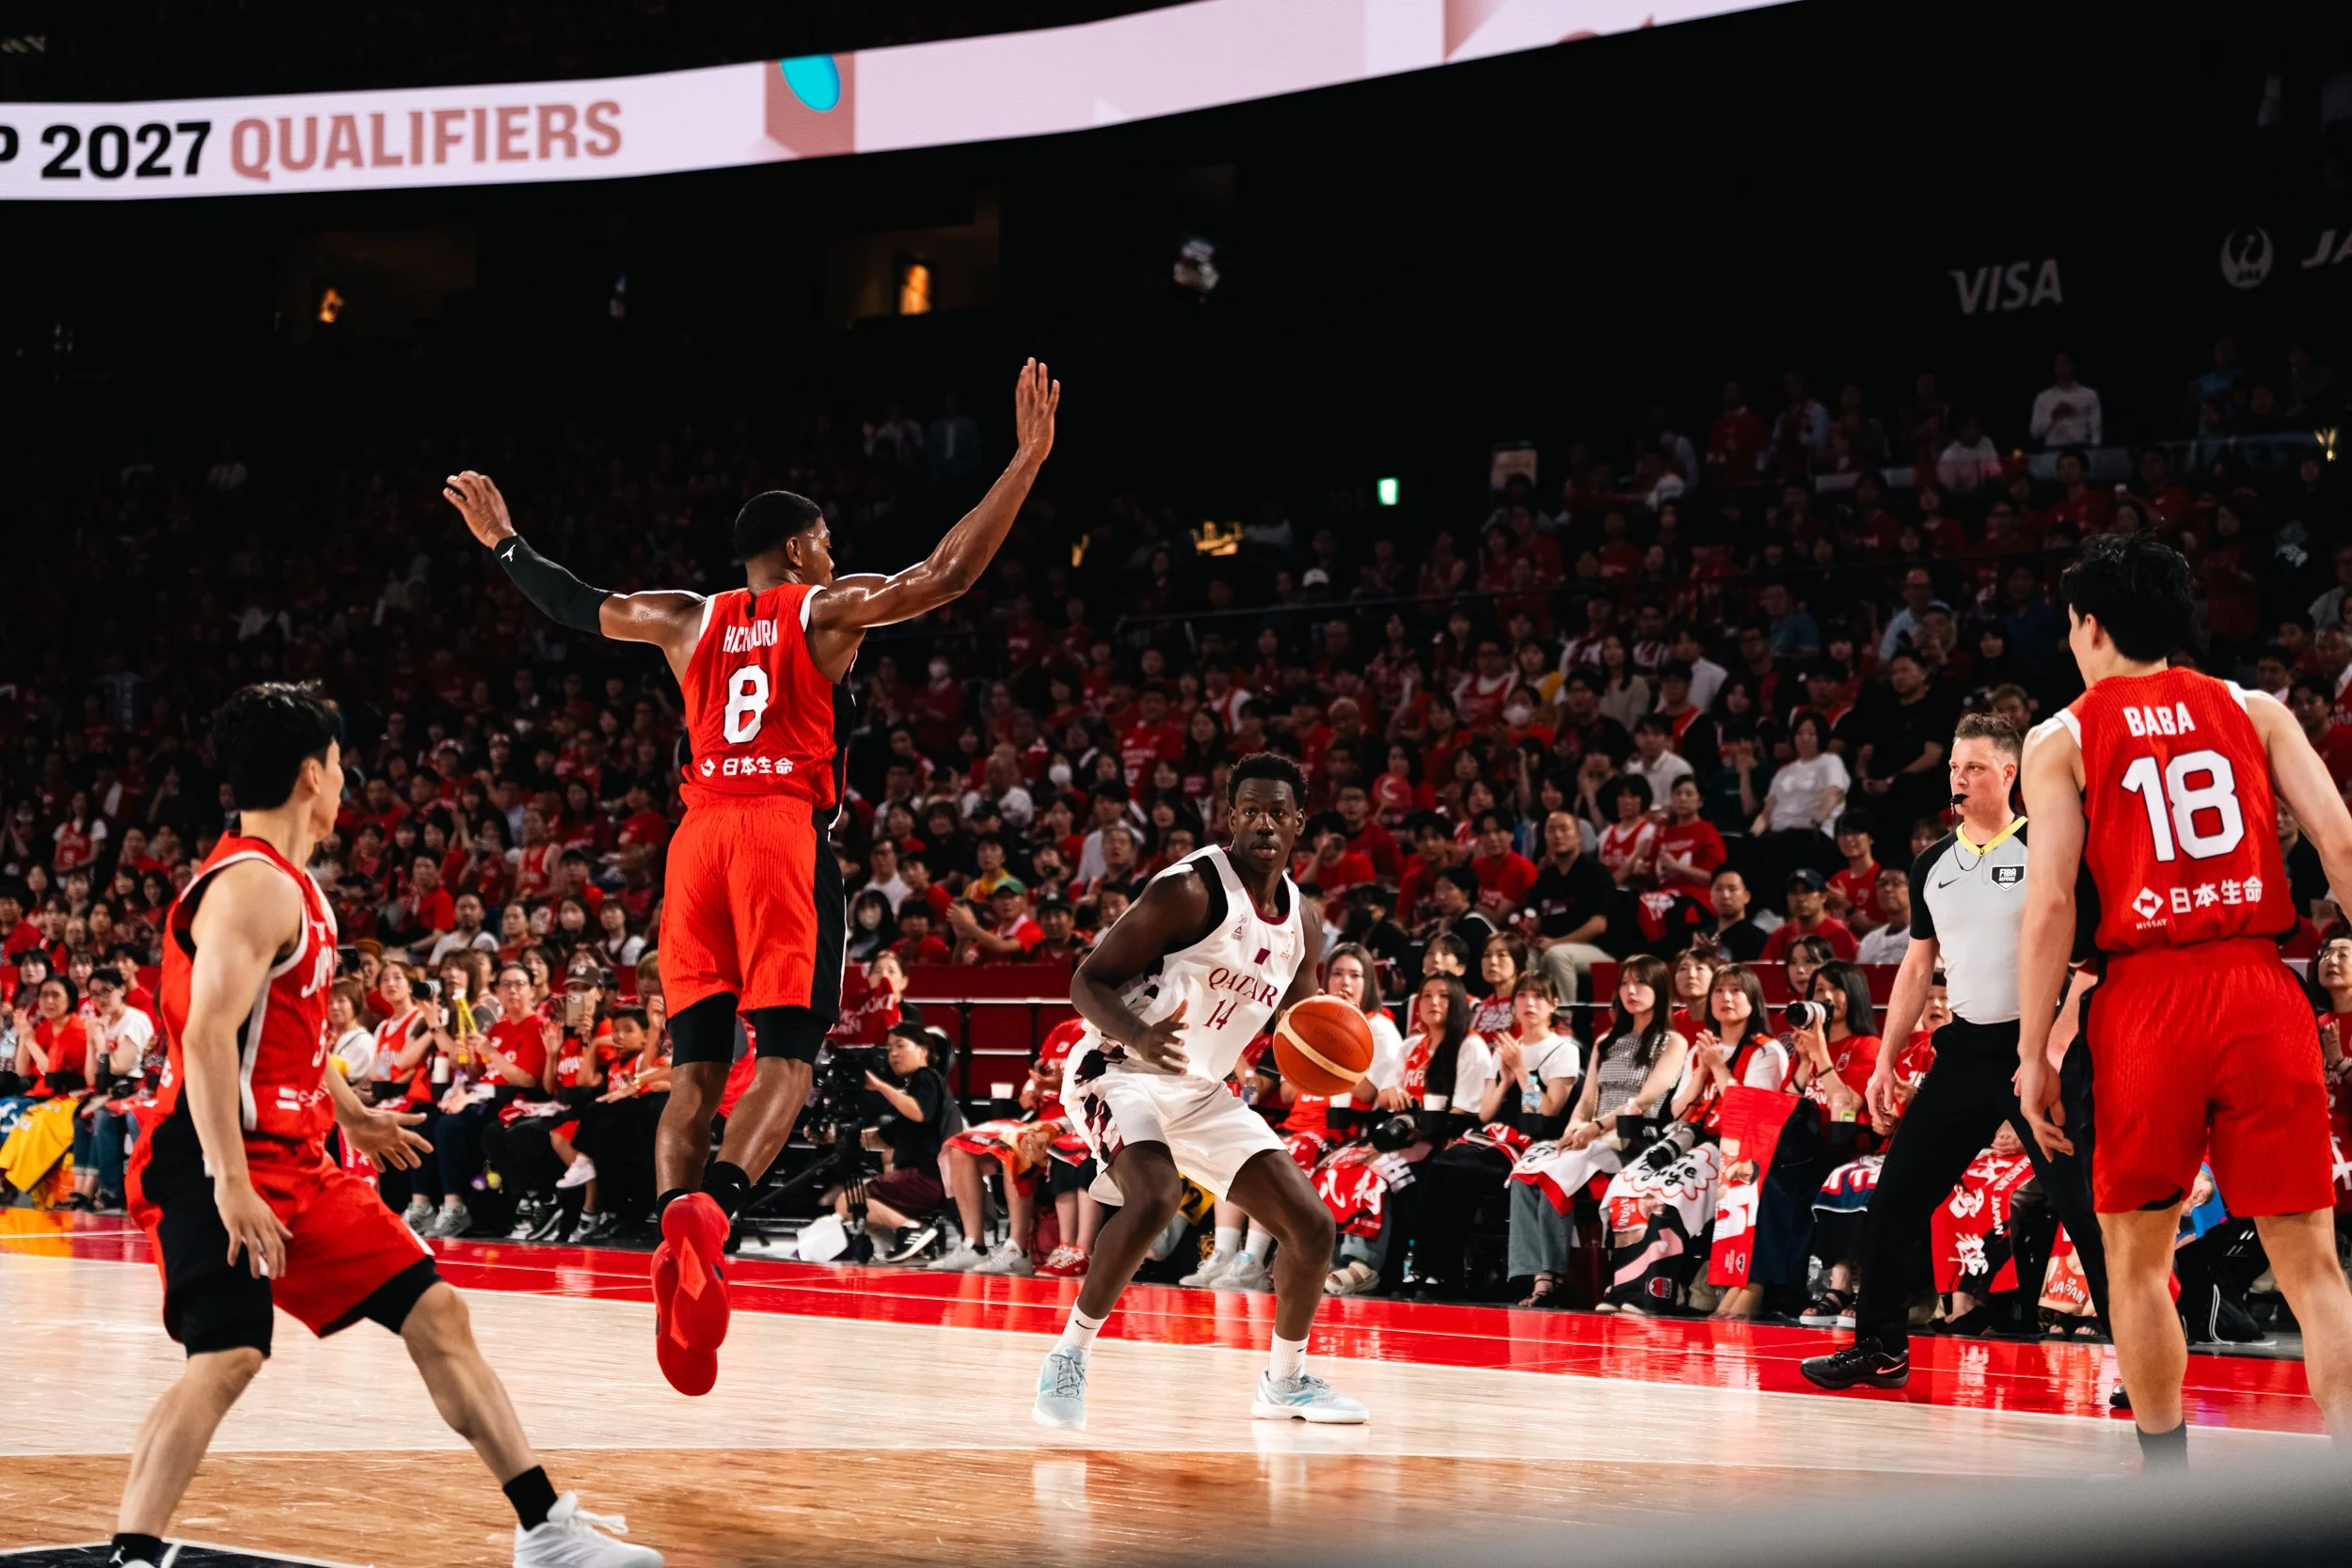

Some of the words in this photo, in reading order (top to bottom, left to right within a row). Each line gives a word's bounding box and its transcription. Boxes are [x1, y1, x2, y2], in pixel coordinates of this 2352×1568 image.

[40, 121, 212, 179] 2027
[230, 100, 622, 183] QUALIFIERS
[1948, 259, 2063, 315] VISA
[723, 664, 770, 745] 8
[2122, 701, 2196, 737] BABA
[723, 756, 794, 776] 日本生命
[2121, 749, 2245, 863] 18
[1999, 868, 2017, 878] FIBA
[2169, 876, 2264, 914] 日本生命
[2136, 919, 2168, 930] NISSAY
[1208, 967, 1279, 1008] QATAR
[1203, 999, 1237, 1031] 14
[1991, 1196, 2005, 1235] JAPAN
[2049, 1281, 2086, 1304] JAPAN
